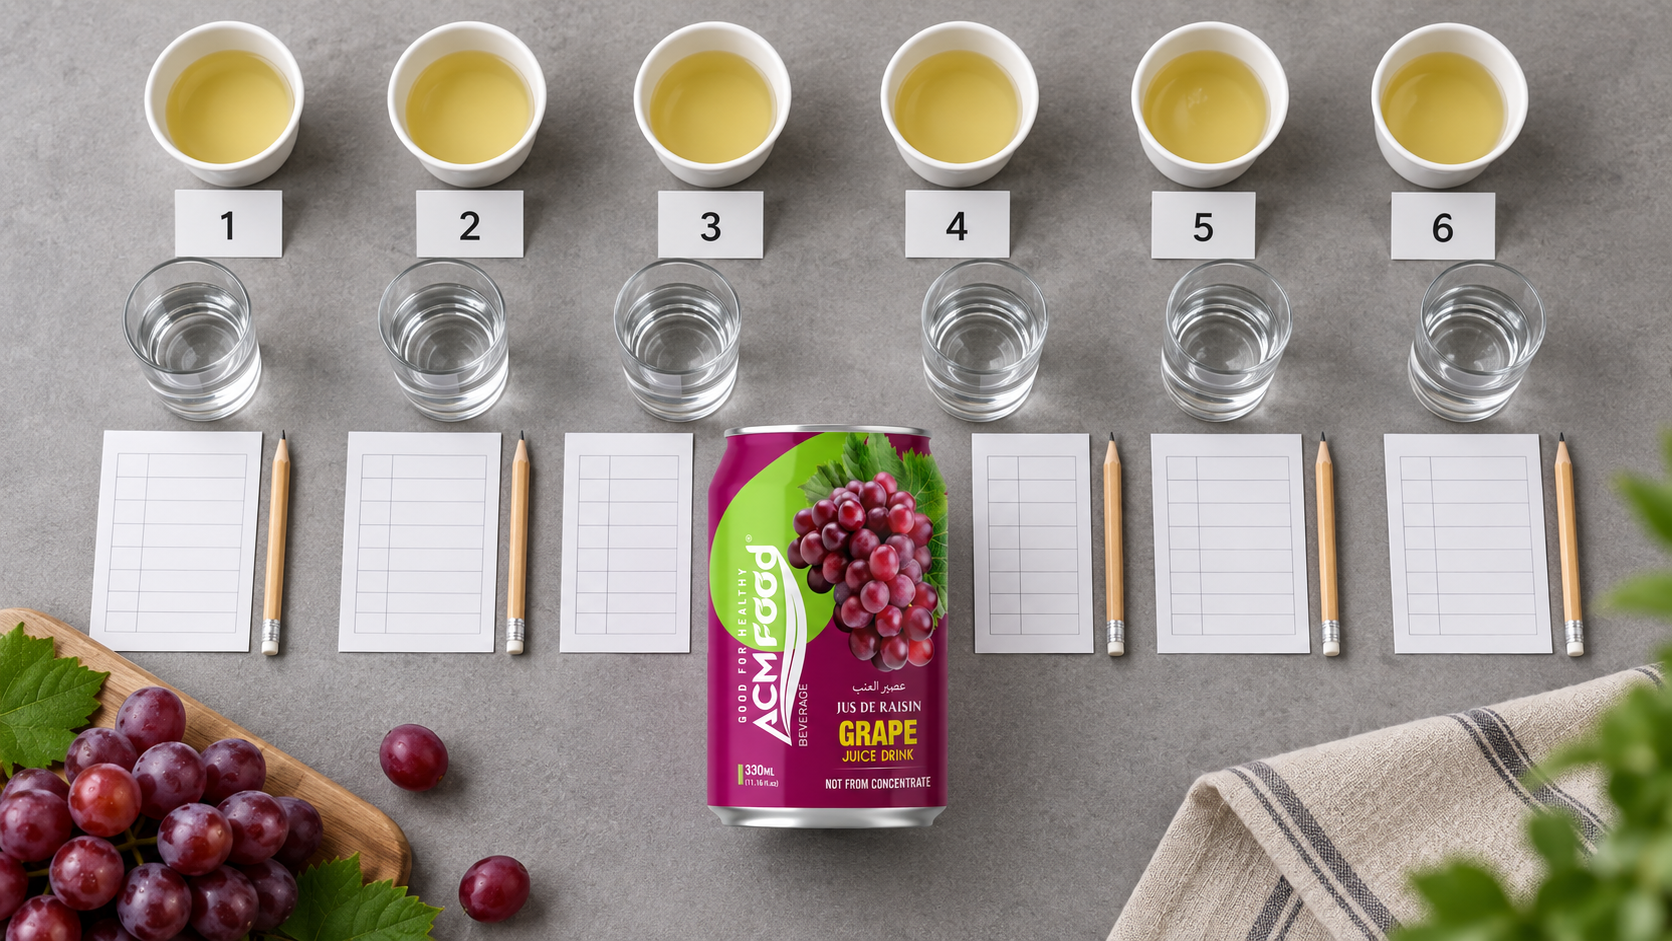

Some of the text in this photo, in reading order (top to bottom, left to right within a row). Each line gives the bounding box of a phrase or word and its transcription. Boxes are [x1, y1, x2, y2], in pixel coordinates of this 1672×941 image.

[220, 211, 233, 241] 1
[459, 210, 481, 241] 2
[700, 211, 722, 242] 3
[945, 211, 968, 241] 4
[1193, 212, 1214, 242] 5
[1432, 212, 1454, 243] 6
[737, 568, 747, 723] GOOD FOR HEALTHY
[852, 681, 906, 695] عصير العنب
[798, 683, 808, 747] BEVERAGE
[836, 700, 922, 715] JUS DE RAISIN
[838, 719, 918, 747] GRAPE
[745, 764, 775, 777] 330ML
[842, 748, 914, 763] JUICE DRINK
[825, 776, 931, 790] NOT FROM CONCENTRATE
